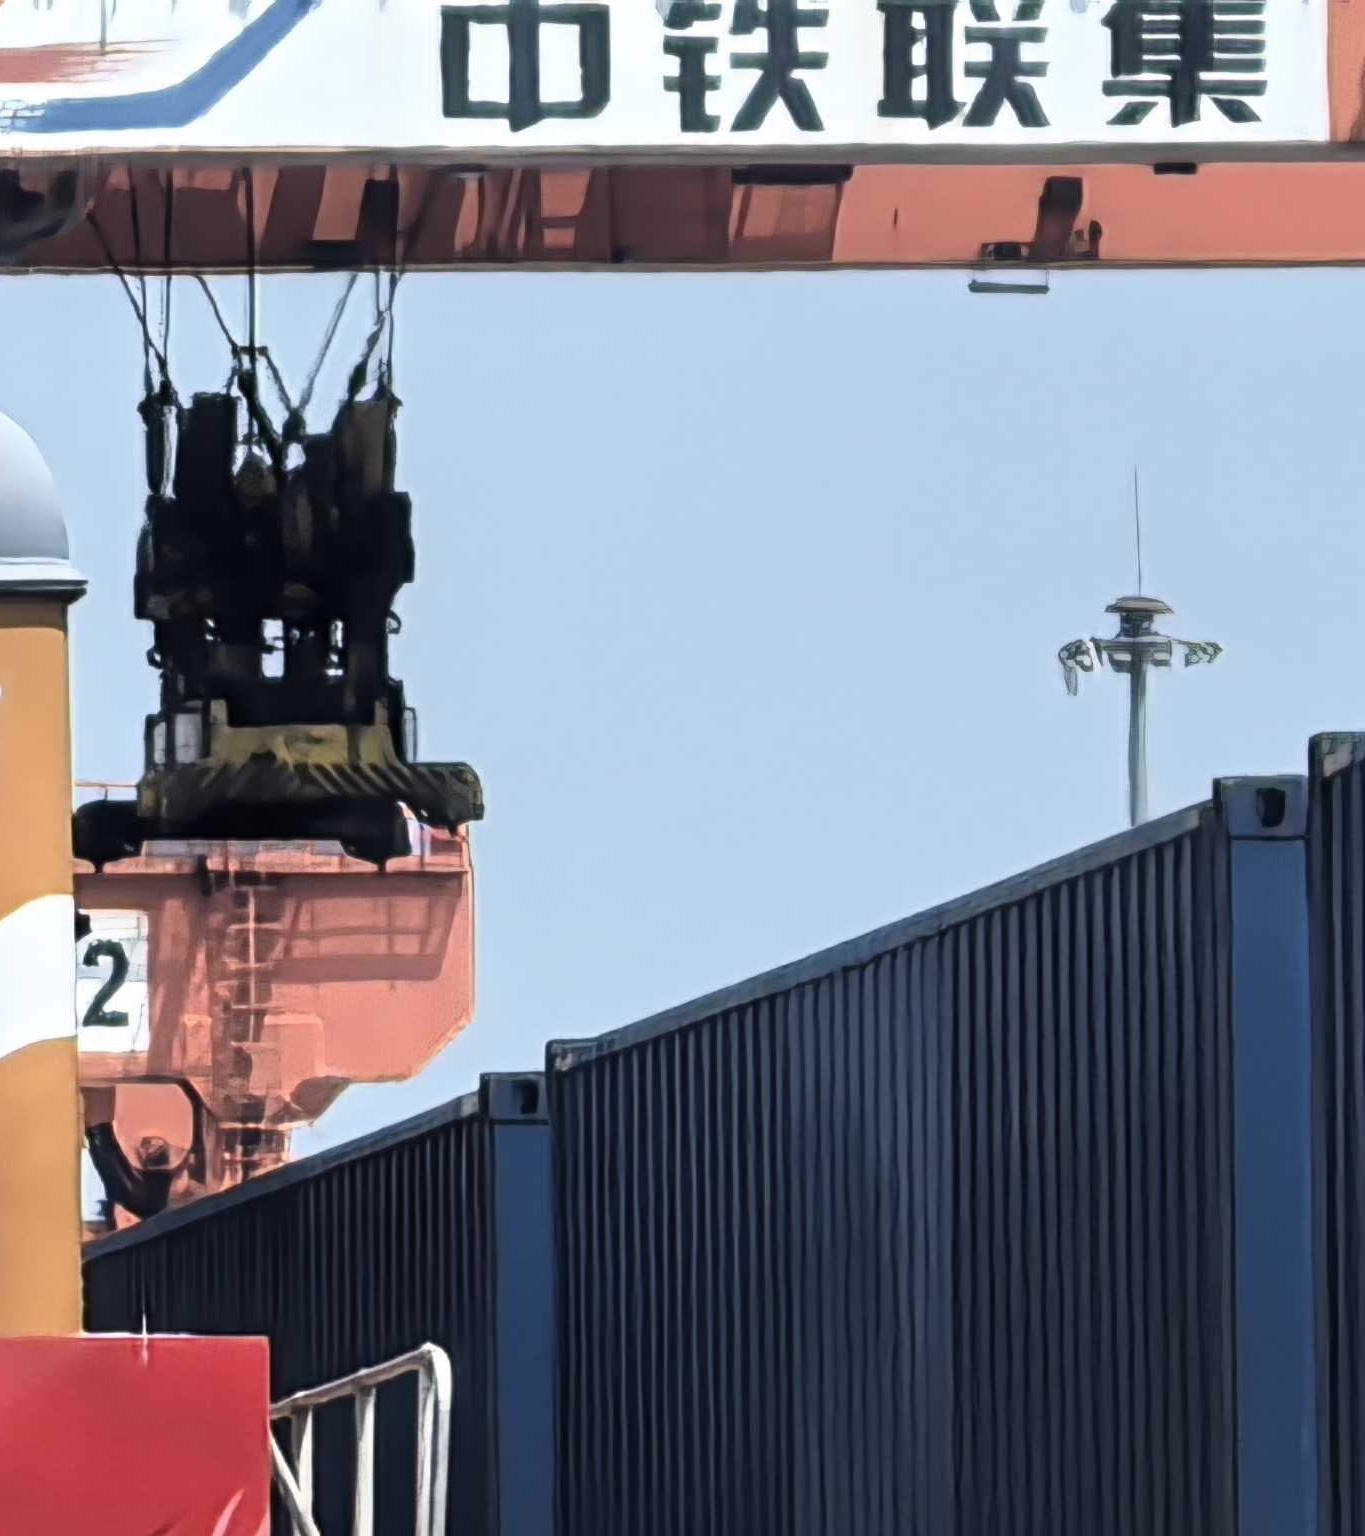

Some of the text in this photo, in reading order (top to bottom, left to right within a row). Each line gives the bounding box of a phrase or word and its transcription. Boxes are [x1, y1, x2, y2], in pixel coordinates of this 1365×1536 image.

[440, 0, 1267, 131] 中铁联集
[82, 938, 130, 1027] 2
